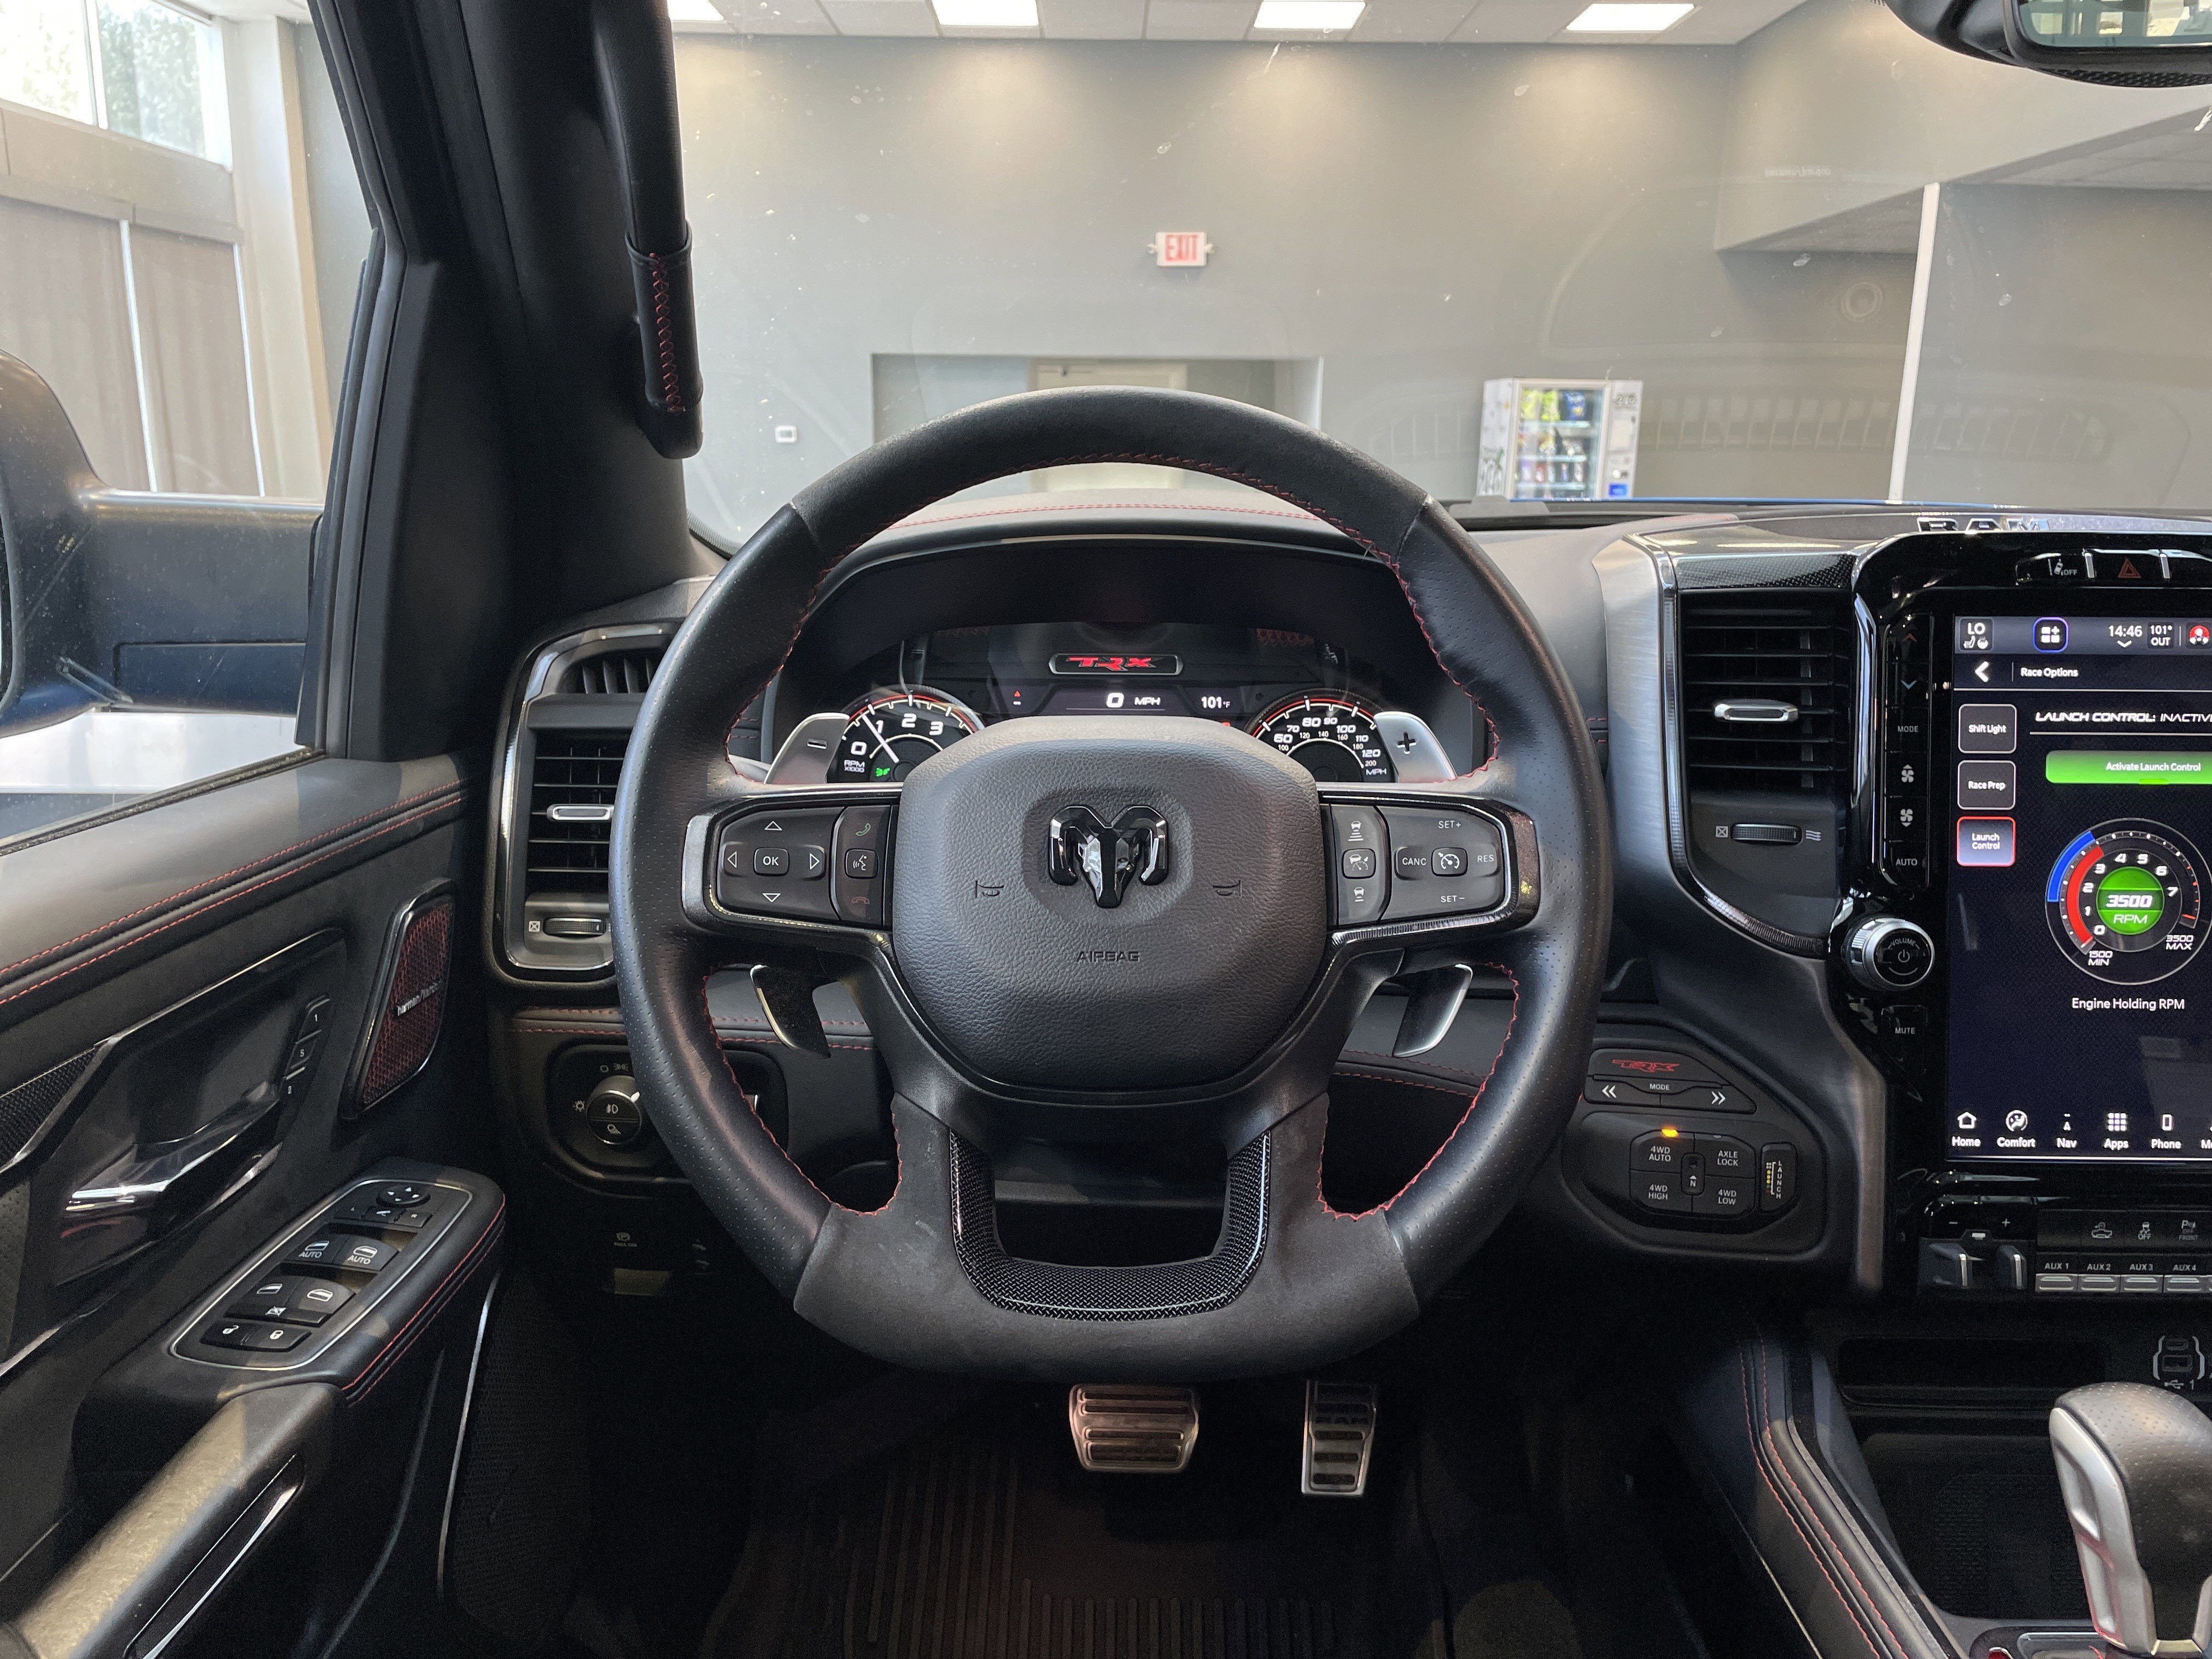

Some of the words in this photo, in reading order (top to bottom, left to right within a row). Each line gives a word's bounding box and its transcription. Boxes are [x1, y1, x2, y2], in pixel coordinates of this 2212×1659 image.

[1165, 234, 1198, 261] EXIT
[1917, 517, 2050, 532] RAM
[2063, 568, 2078, 577] OFF
[1967, 623, 1985, 635] LO
[2108, 625, 2142, 637] 14:46
[2149, 625, 2172, 636] 101°
[2151, 637, 2171, 646] OUT
[1069, 657, 1155, 671] TRX
[2021, 667, 2042, 677] Race
[2044, 667, 2078, 679] Options
[1107, 693, 1125, 708] 0
[1135, 697, 1161, 706] MPH
[901, 714, 916, 728] 2
[1302, 717, 1322, 727] 80
[1323, 718, 1338, 726] 90
[2035, 712, 2090, 722] LAUNCH
[2092, 712, 2156, 723] CONTROL:
[2160, 713, 2212, 723] INACTIV
[876, 720, 883, 732] 1
[929, 721, 944, 735] 3
[1286, 724, 1300, 733] 70
[1336, 725, 1357, 733] 100
[1898, 725, 1919, 733] MODE
[1968, 724, 1985, 733] Shift
[1987, 724, 2006, 736] Light
[1274, 733, 1293, 743] 60
[1355, 735, 1369, 743] 110
[851, 741, 867, 755] 0
[1362, 749, 1381, 758] 120
[844, 759, 865, 768] RPM
[2106, 761, 2138, 771] Activate
[2140, 762, 2169, 771] Launch
[2170, 763, 2201, 772] Control
[1365, 768, 1387, 776] MPH
[1968, 781, 1987, 790] Race
[1988, 781, 2006, 792] Prep
[1972, 832, 2000, 842] Launch
[1972, 840, 2000, 850] Control
[763, 856, 780, 867] OK
[1402, 857, 1426, 866] CANC
[1477, 854, 1494, 863] RES
[1895, 858, 1918, 866] AUTO
[2115, 853, 2126, 863] 4
[2137, 854, 2148, 864] 5
[2094, 864, 2106, 873] 3
[2156, 865, 2168, 876] 6
[2083, 883, 2094, 893] 2
[2167, 887, 2179, 896] 7
[2106, 895, 2152, 908] 3500
[2085, 906, 2091, 916] 1
[2113, 914, 2148, 924] RPM
[2094, 926, 2106, 936] 0
[1891, 938, 1916, 946] VOLUME
[2166, 935, 2194, 943] 3500
[2165, 943, 2193, 951] MAX
[1076, 950, 1141, 963] AIRBAG
[2088, 950, 2113, 959] 1500
[2087, 958, 2110, 966] MIN
[2072, 998, 2111, 1011] Engine
[2112, 998, 2157, 1011] Holding
[2158, 998, 2185, 1009] RPM
[1894, 1026, 1916, 1035] MUTE
[1951, 1136, 1980, 1147] Home
[1996, 1137, 2036, 1148] Comfort
[2056, 1138, 2077, 1148] Nav
[2104, 1139, 2129, 1150] Apps
[2151, 1139, 2181, 1149] Phone
[2201, 1139, 2212, 1149] M
[1650, 1145, 1671, 1154] 4WD
[1649, 1153, 1671, 1162] AUTO
[1718, 1150, 1739, 1159] AXLE
[1717, 1157, 1739, 1166] LOCK
[1649, 1184, 1668, 1192] 4WD
[1648, 1191, 1668, 1200] HIGH
[1718, 1189, 1737, 1197] 4WD
[1718, 1196, 1736, 1205] LOW
[2138, 1232, 2151, 1240] OFF
[347, 1255, 371, 1265] AUTO
[2045, 1262, 2062, 1270] AUX
[2087, 1263, 2104, 1271] AUX
[2129, 1263, 2146, 1272] AUX
[2172, 1264, 2188, 1272] AUX
[2190, 1379, 2194, 1390] 1
